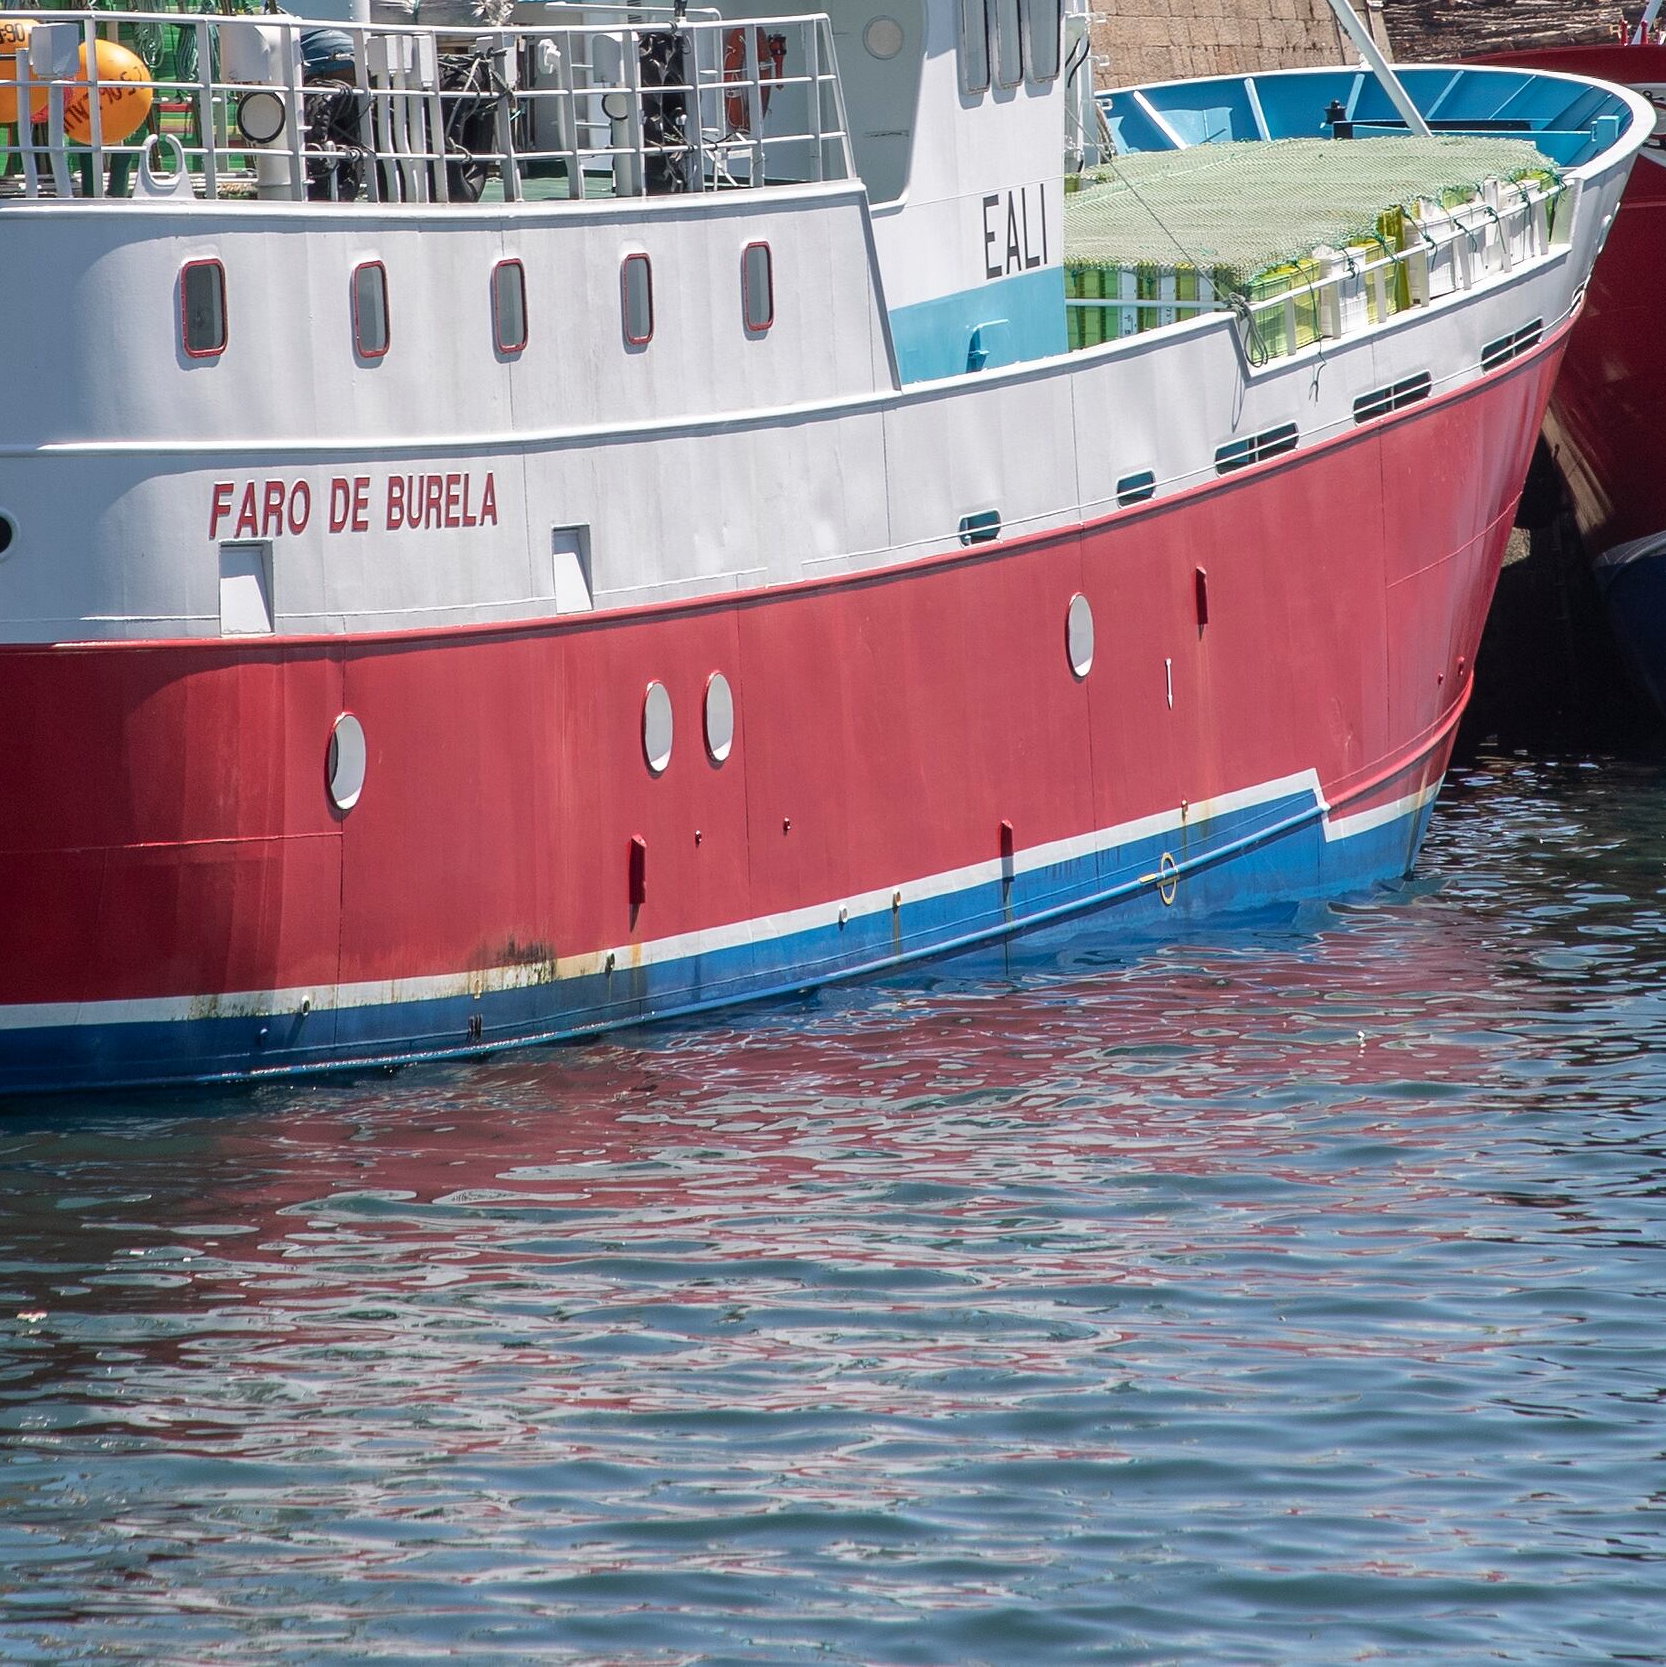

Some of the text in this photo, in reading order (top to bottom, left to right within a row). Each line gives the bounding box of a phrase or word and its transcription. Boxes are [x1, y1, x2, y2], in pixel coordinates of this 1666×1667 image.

[983, 183, 1047, 280] EALI
[209, 471, 498, 540] FARO DE BURELA
